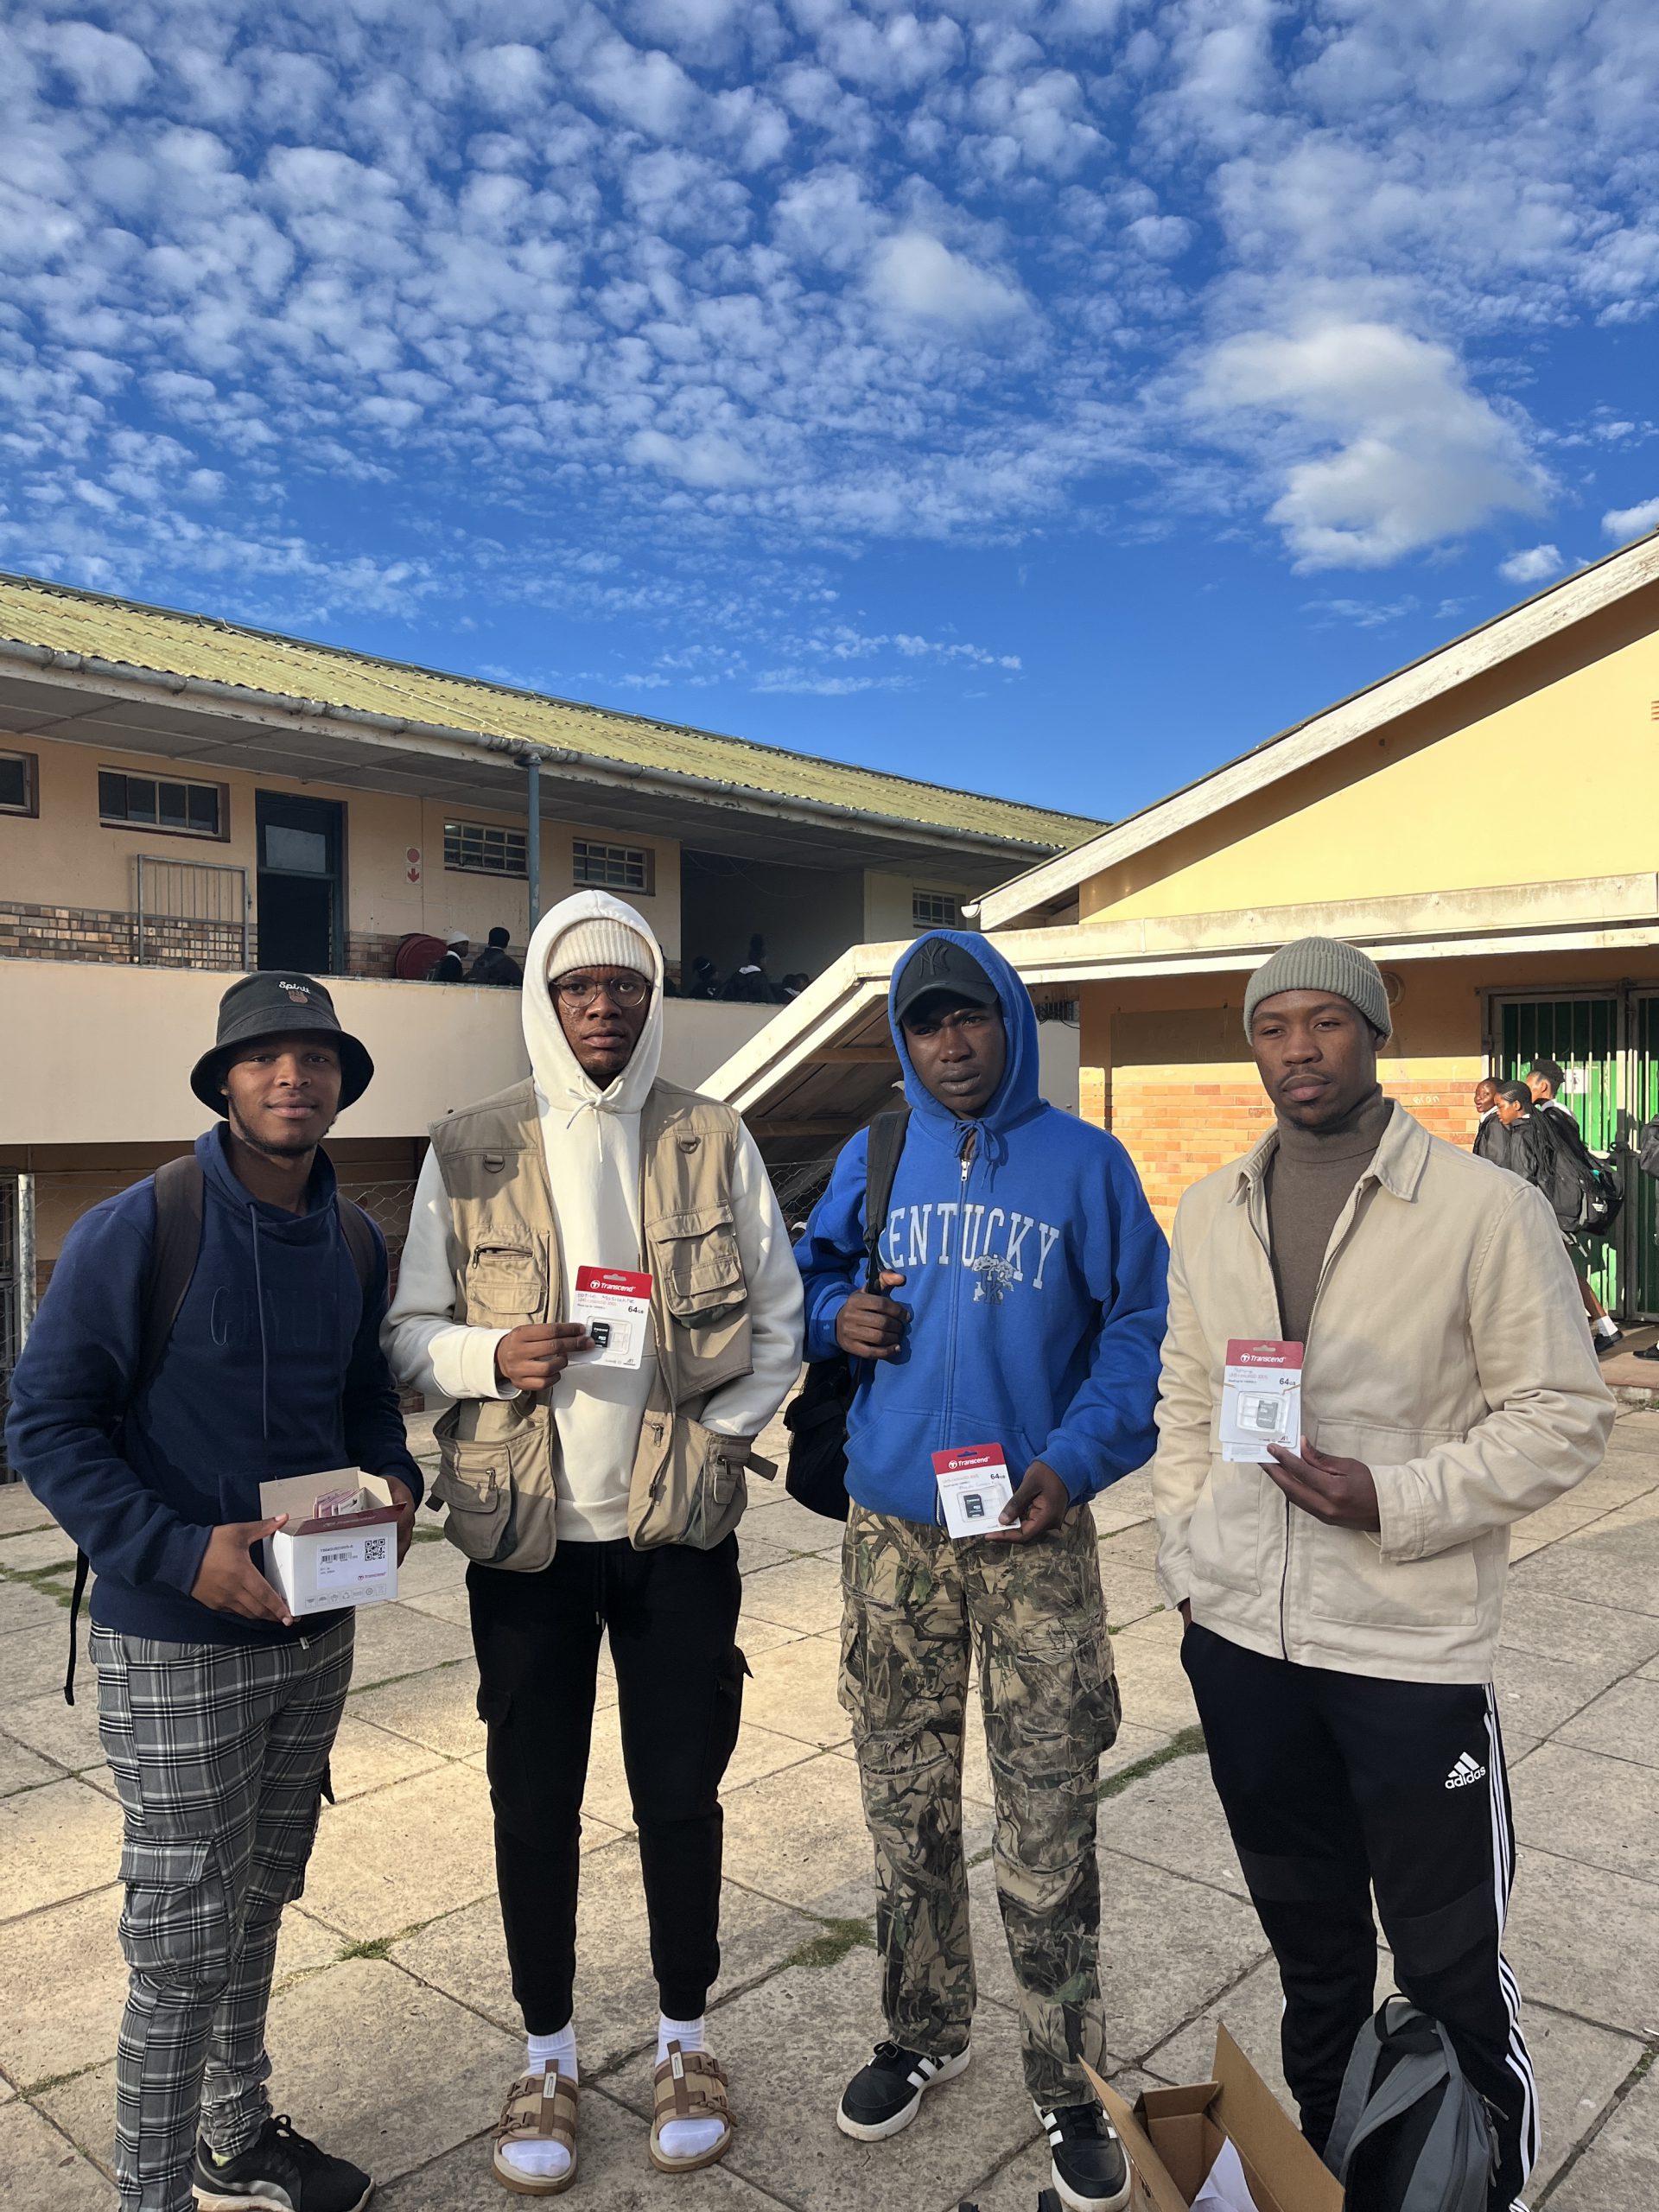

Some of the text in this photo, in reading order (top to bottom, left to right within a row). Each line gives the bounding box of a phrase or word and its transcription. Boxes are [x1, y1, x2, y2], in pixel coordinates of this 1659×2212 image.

[878, 1202, 1060, 1290] ENTUCKY
[601, 1282, 633, 1293] Transcend
[1250, 1354, 1284, 1363] Transcend
[958, 1457, 988, 1466] Transcend
[1445, 1766, 1486, 1789] adidas
